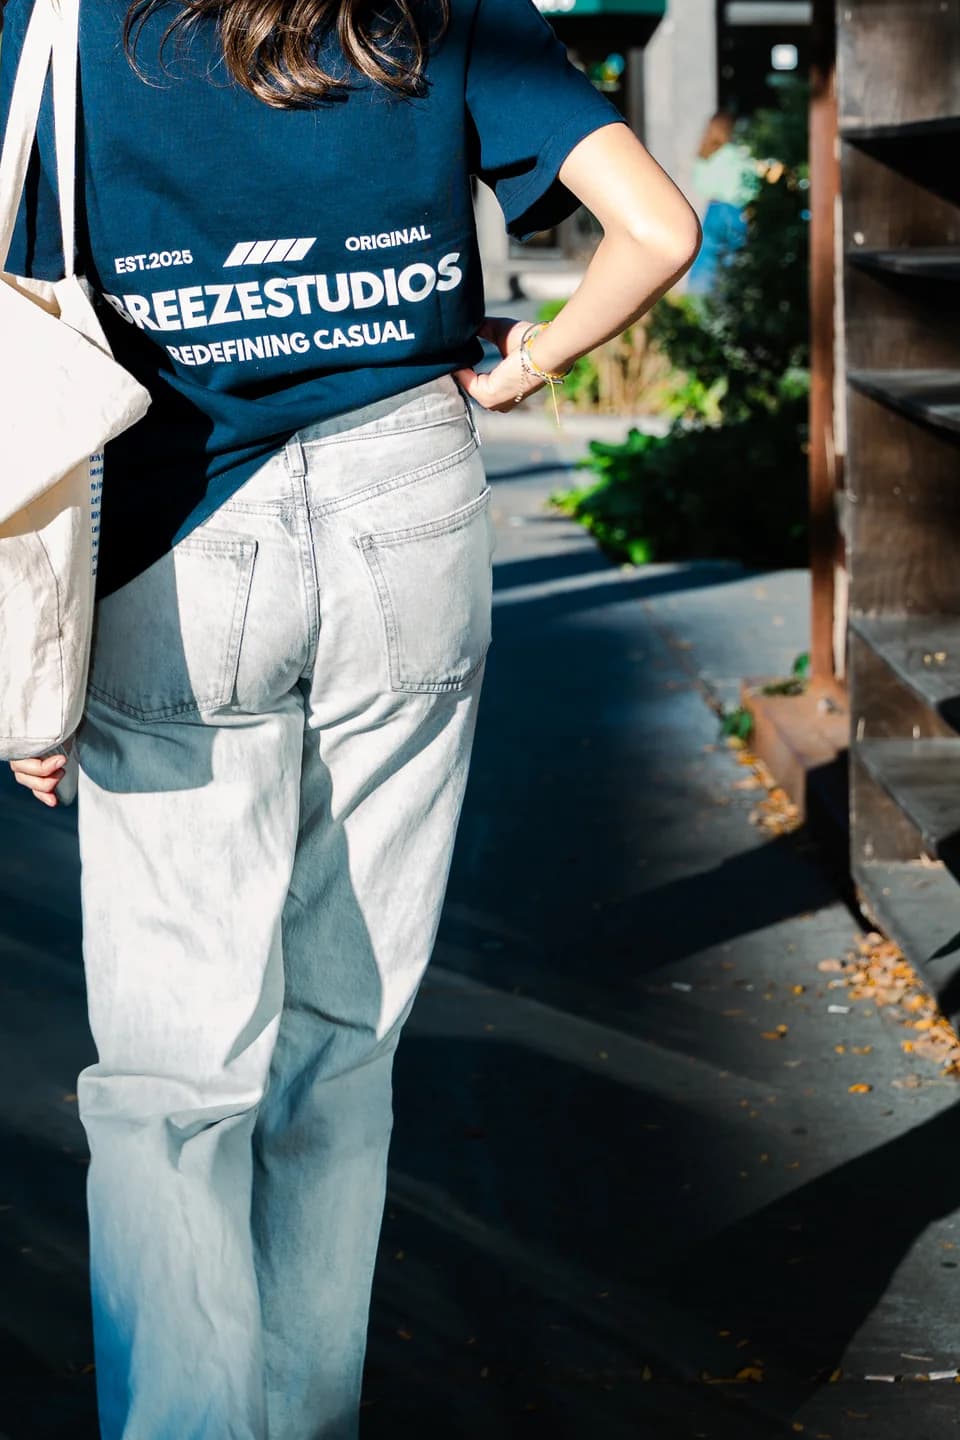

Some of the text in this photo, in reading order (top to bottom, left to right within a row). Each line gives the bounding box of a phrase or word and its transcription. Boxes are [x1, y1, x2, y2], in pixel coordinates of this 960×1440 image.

[345, 225, 431, 251] ORIGINAL
[114, 249, 194, 274] EST.2025
[102, 252, 463, 331] BREEZESTUDIOS
[166, 319, 415, 366] REDEFINING CASUAL
